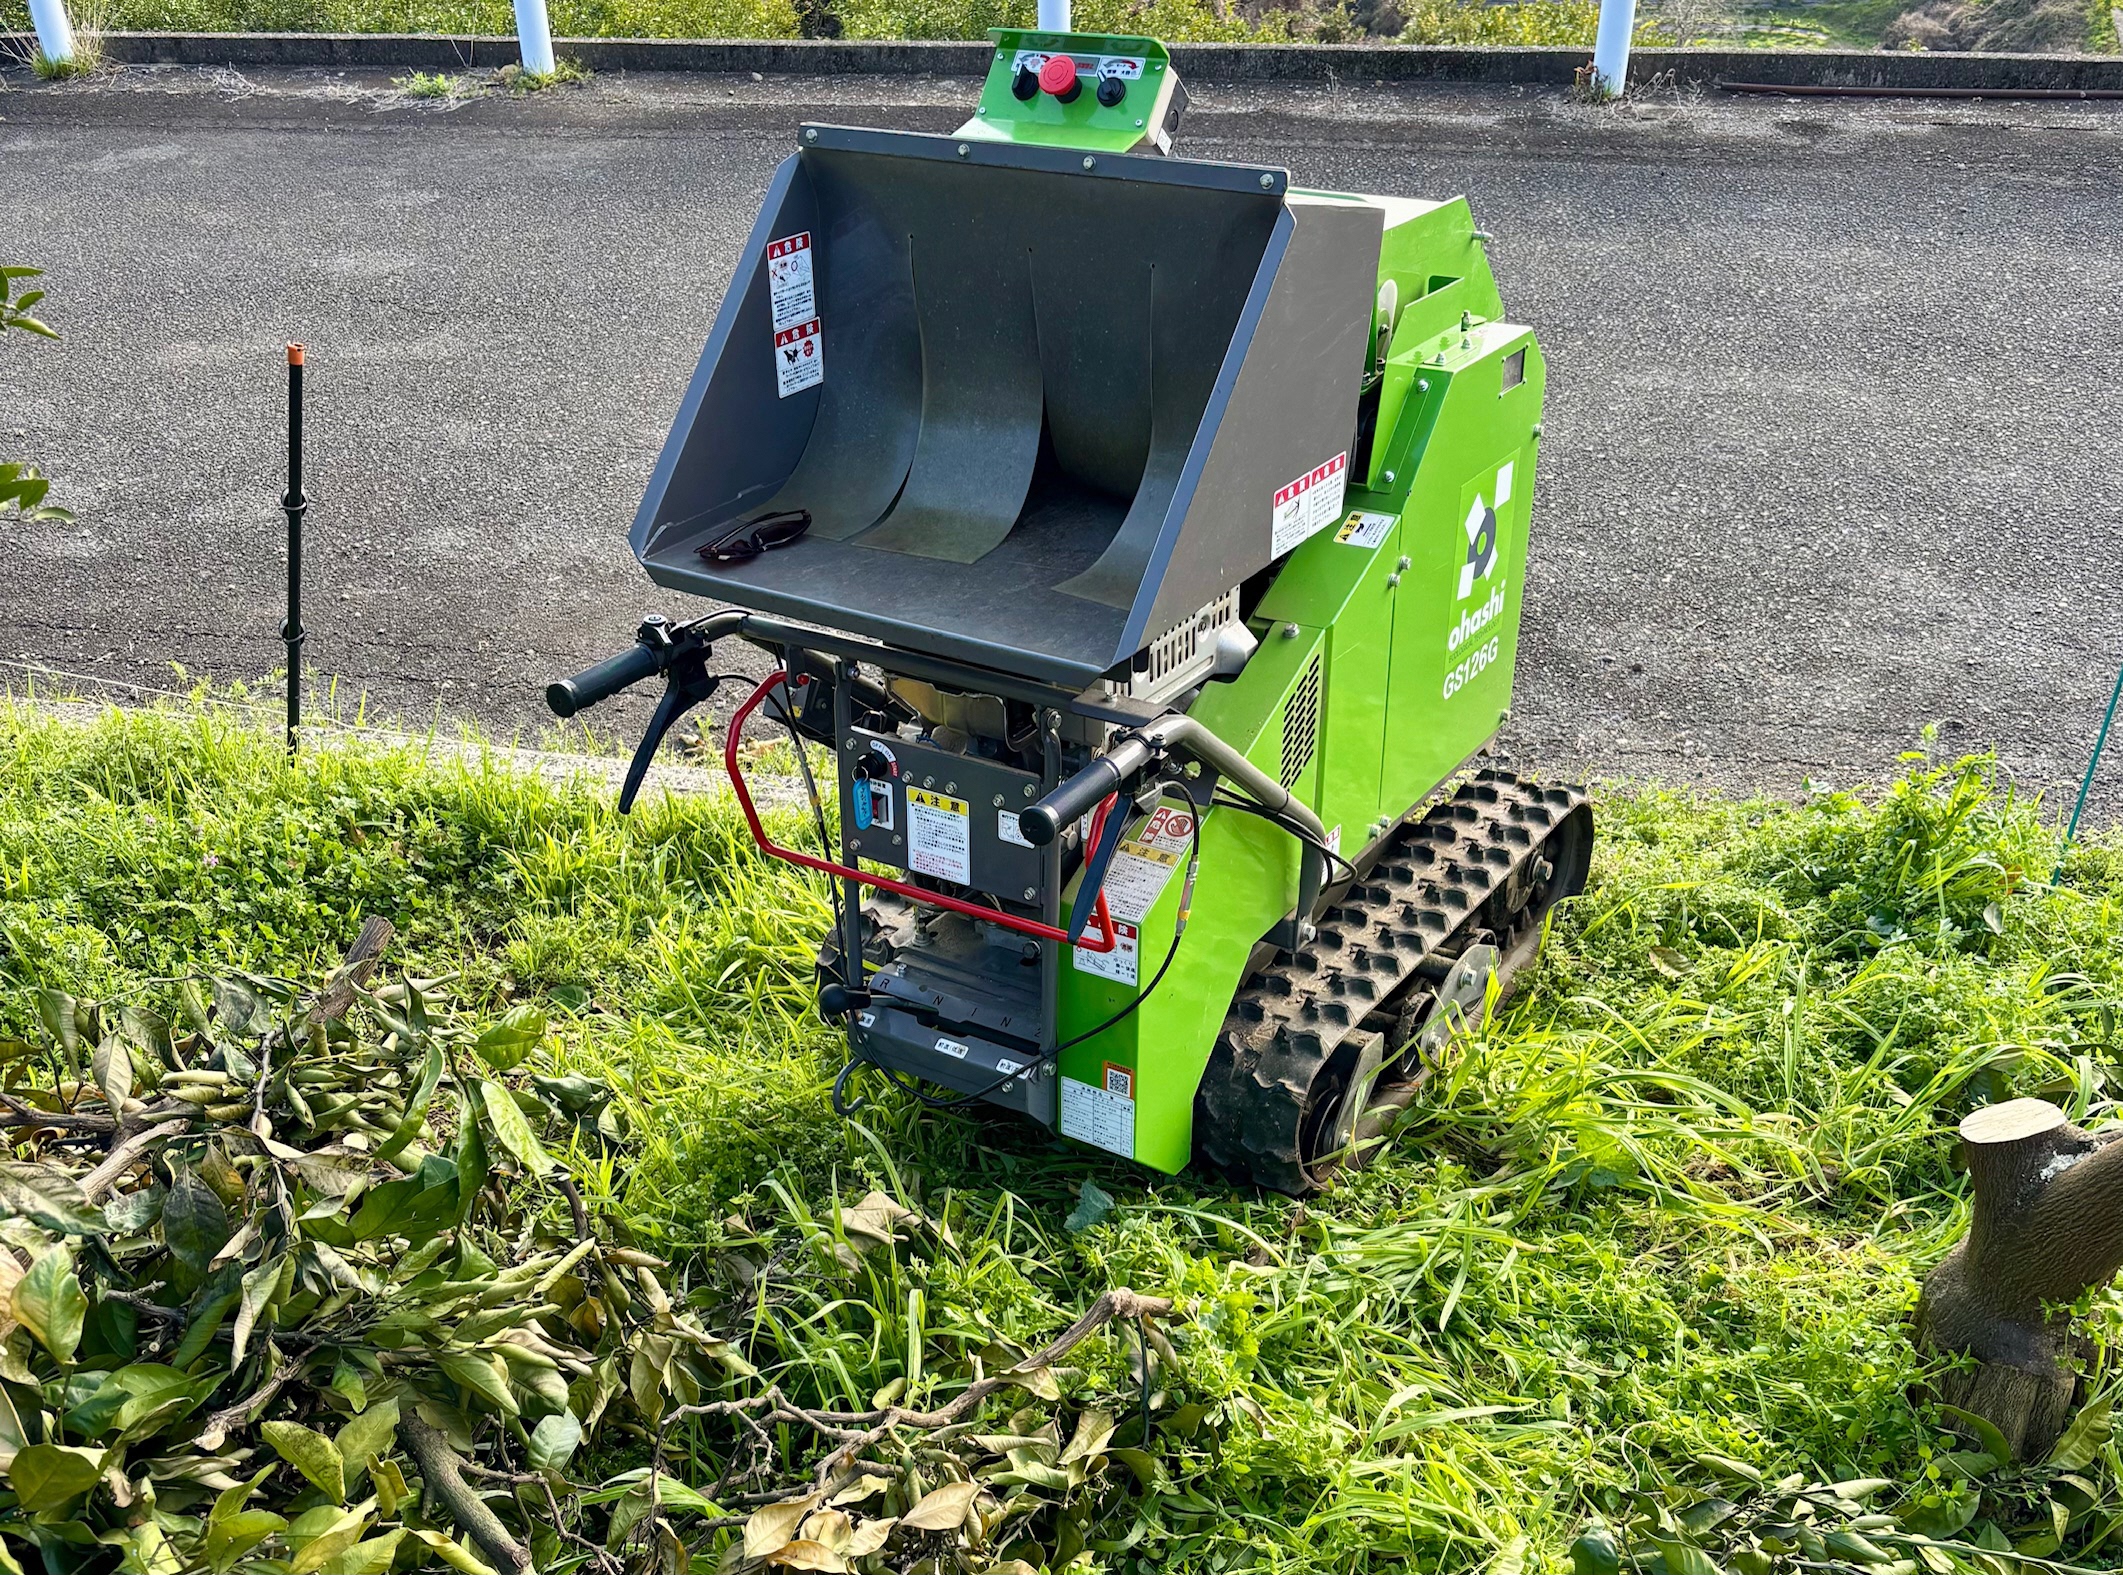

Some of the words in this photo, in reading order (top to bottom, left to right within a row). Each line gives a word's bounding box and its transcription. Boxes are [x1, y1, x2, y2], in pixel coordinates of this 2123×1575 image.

[1448, 579, 1506, 652] ohashi
[1448, 637, 1474, 664] ECOLOGICAL
[1474, 618, 1500, 646] TECHNOLOGY
[1443, 635, 1499, 701] GS126G
[930, 795, 961, 813] 注意
[1136, 846, 1174, 863] 注意
[880, 978, 890, 989] R
[932, 995, 944, 1006] N
[1000, 1016, 1012, 1027] N
